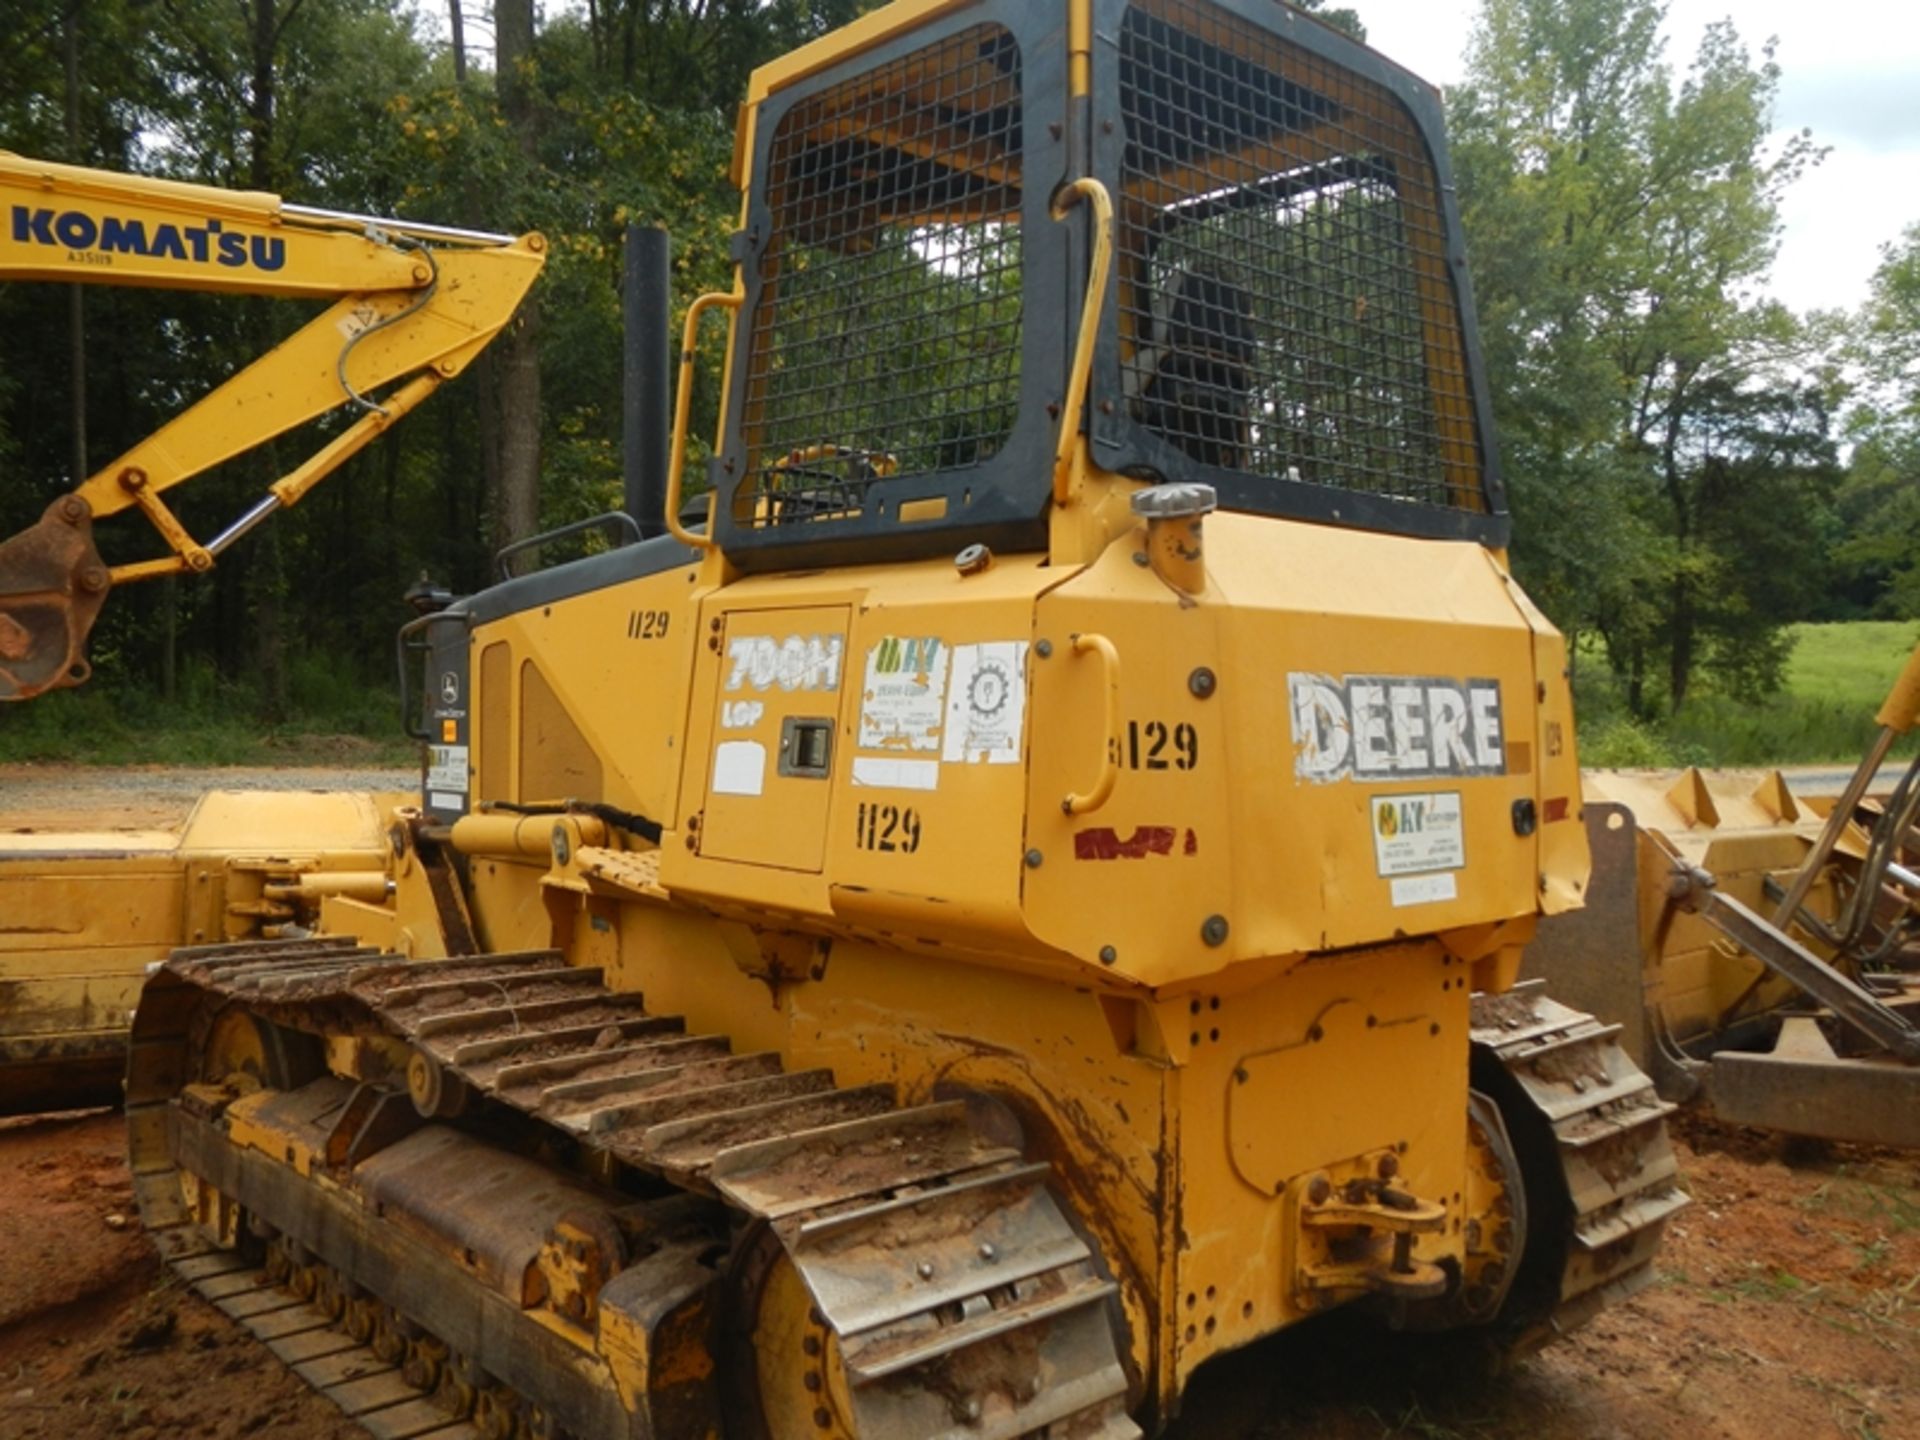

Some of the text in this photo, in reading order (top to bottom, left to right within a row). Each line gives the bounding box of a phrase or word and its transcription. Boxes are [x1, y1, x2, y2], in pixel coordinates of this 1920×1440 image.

[11, 205, 286, 272] KOMATSU
[627, 609, 670, 639] 1129
[1292, 682, 1504, 774] DEERE
[856, 802, 921, 854] 1129
[1378, 801, 1424, 837] MAY
